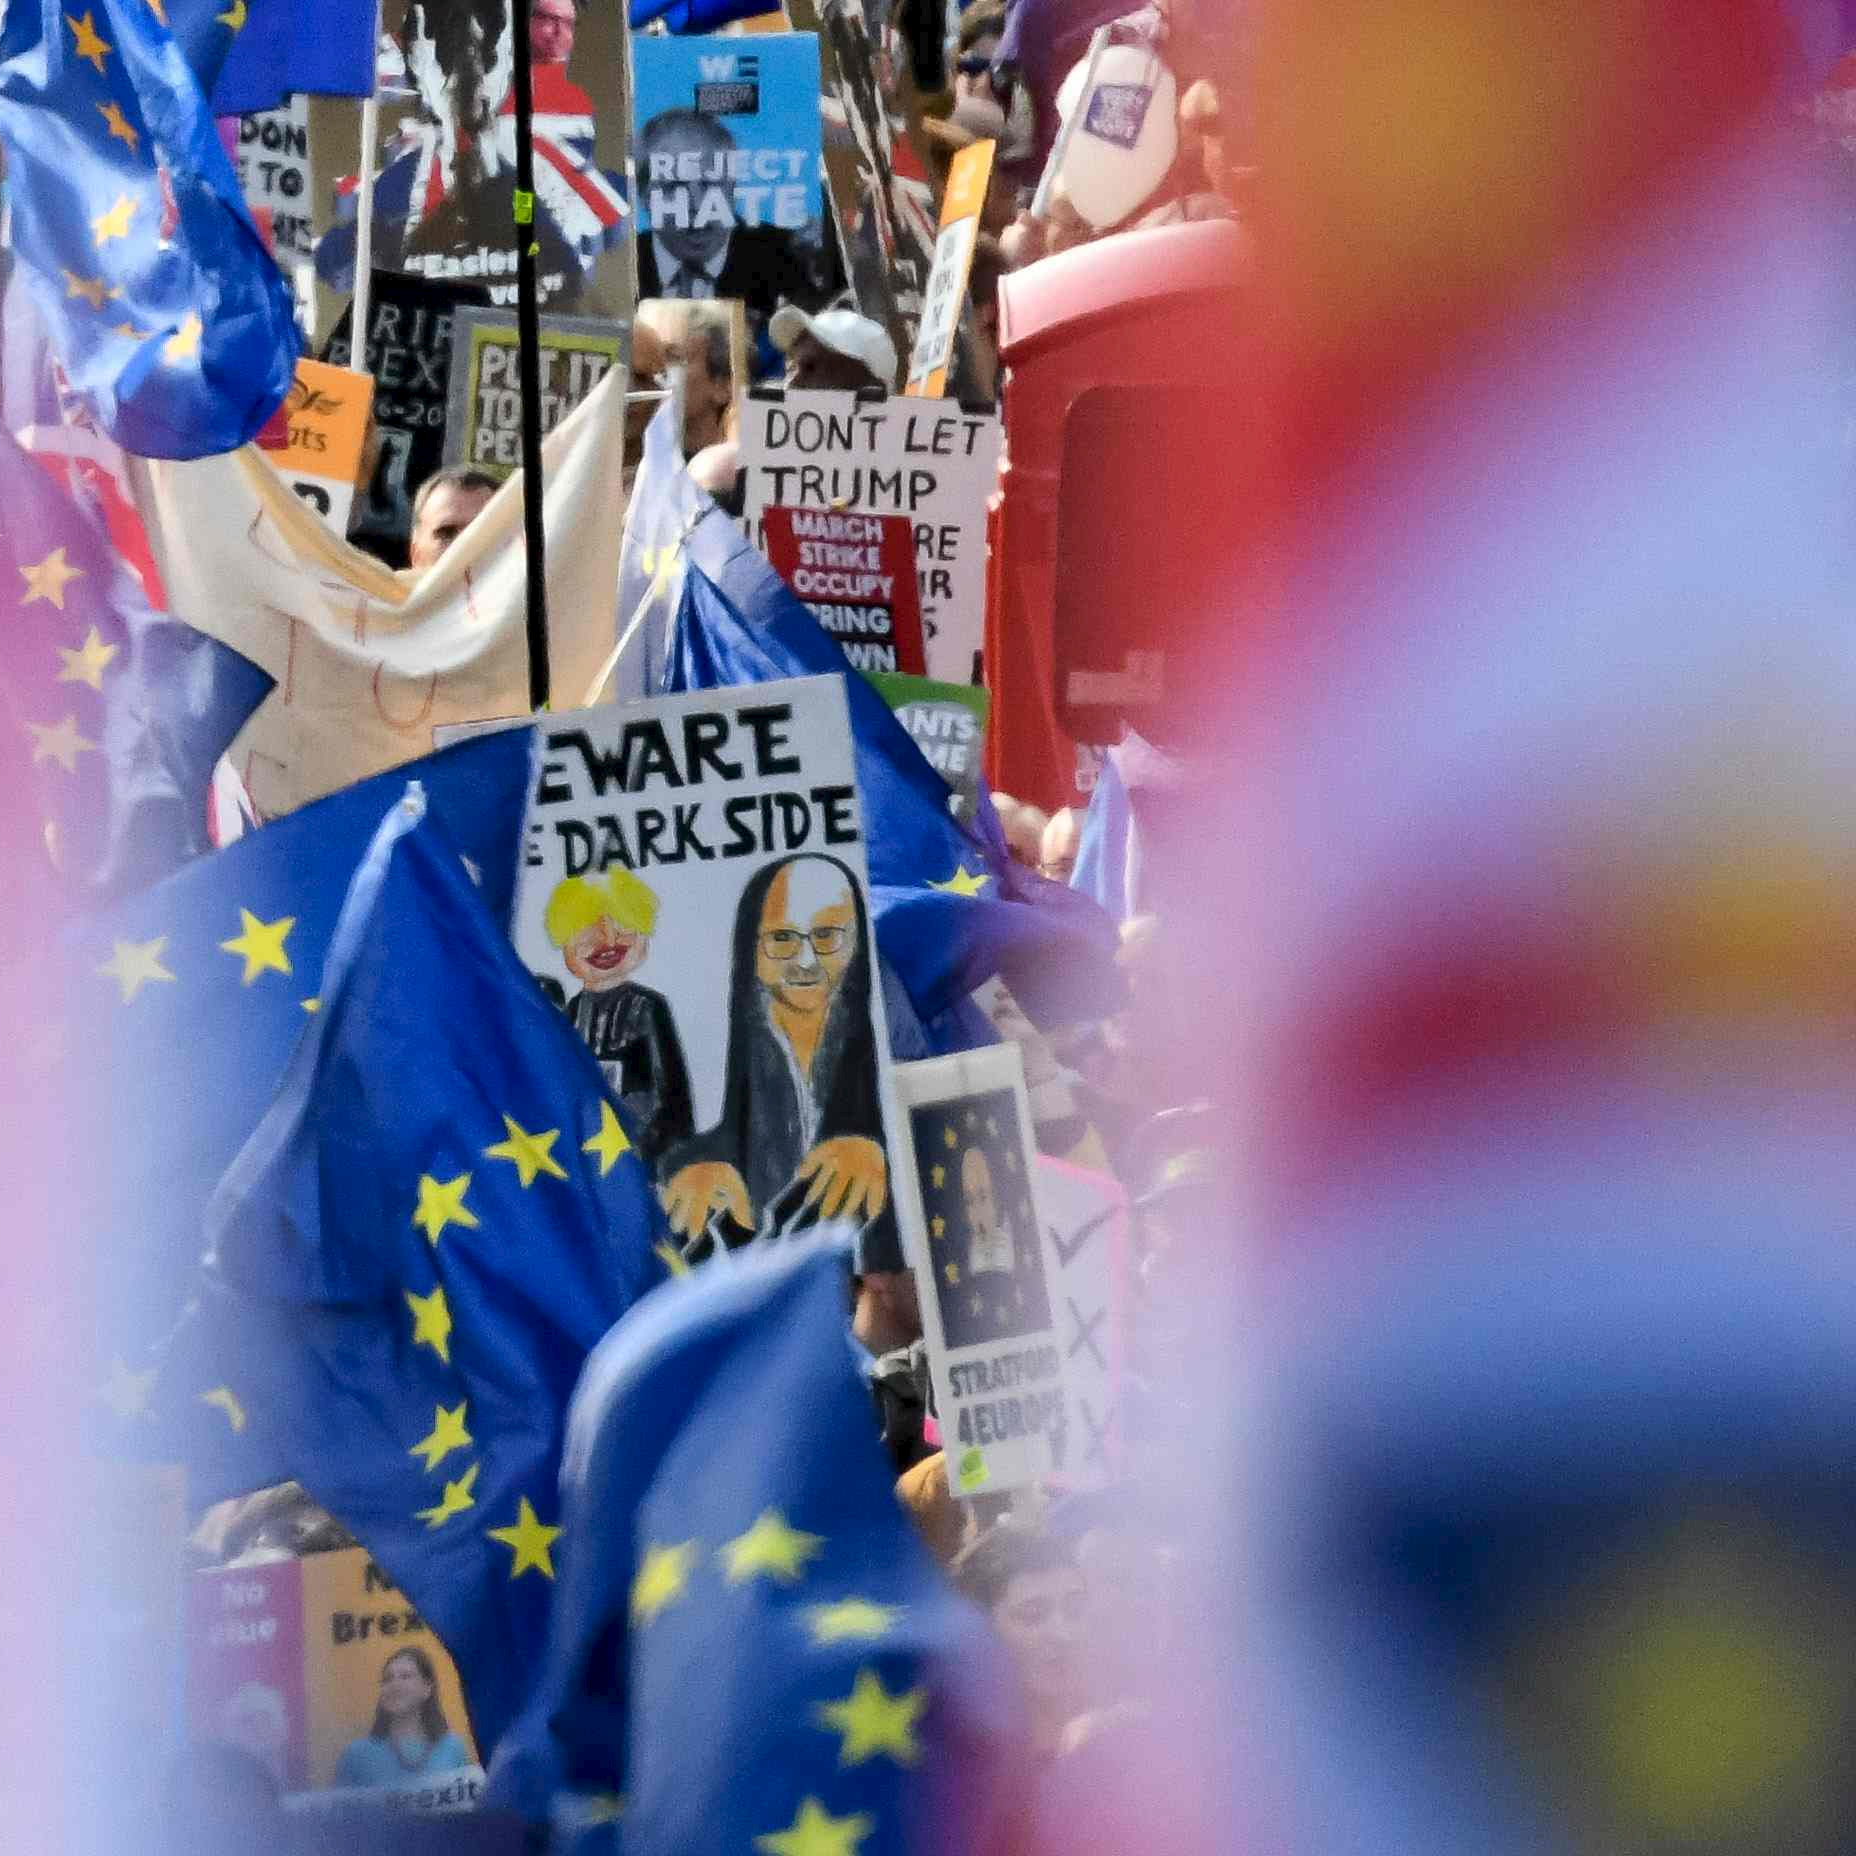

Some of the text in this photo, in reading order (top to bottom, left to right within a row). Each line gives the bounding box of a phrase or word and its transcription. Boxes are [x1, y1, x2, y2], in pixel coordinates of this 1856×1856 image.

[649, 148, 807, 184] REJECT
[649, 186, 809, 230] HATE
[903, 417, 986, 457] LET
[762, 464, 938, 510] TRUMP
[791, 511, 885, 542] MARCH
[798, 542, 882, 572] STRIKE
[792, 570, 894, 599] OCCUPY
[536, 701, 801, 804] EWARE
[558, 786, 859, 876] DARK SIDE
